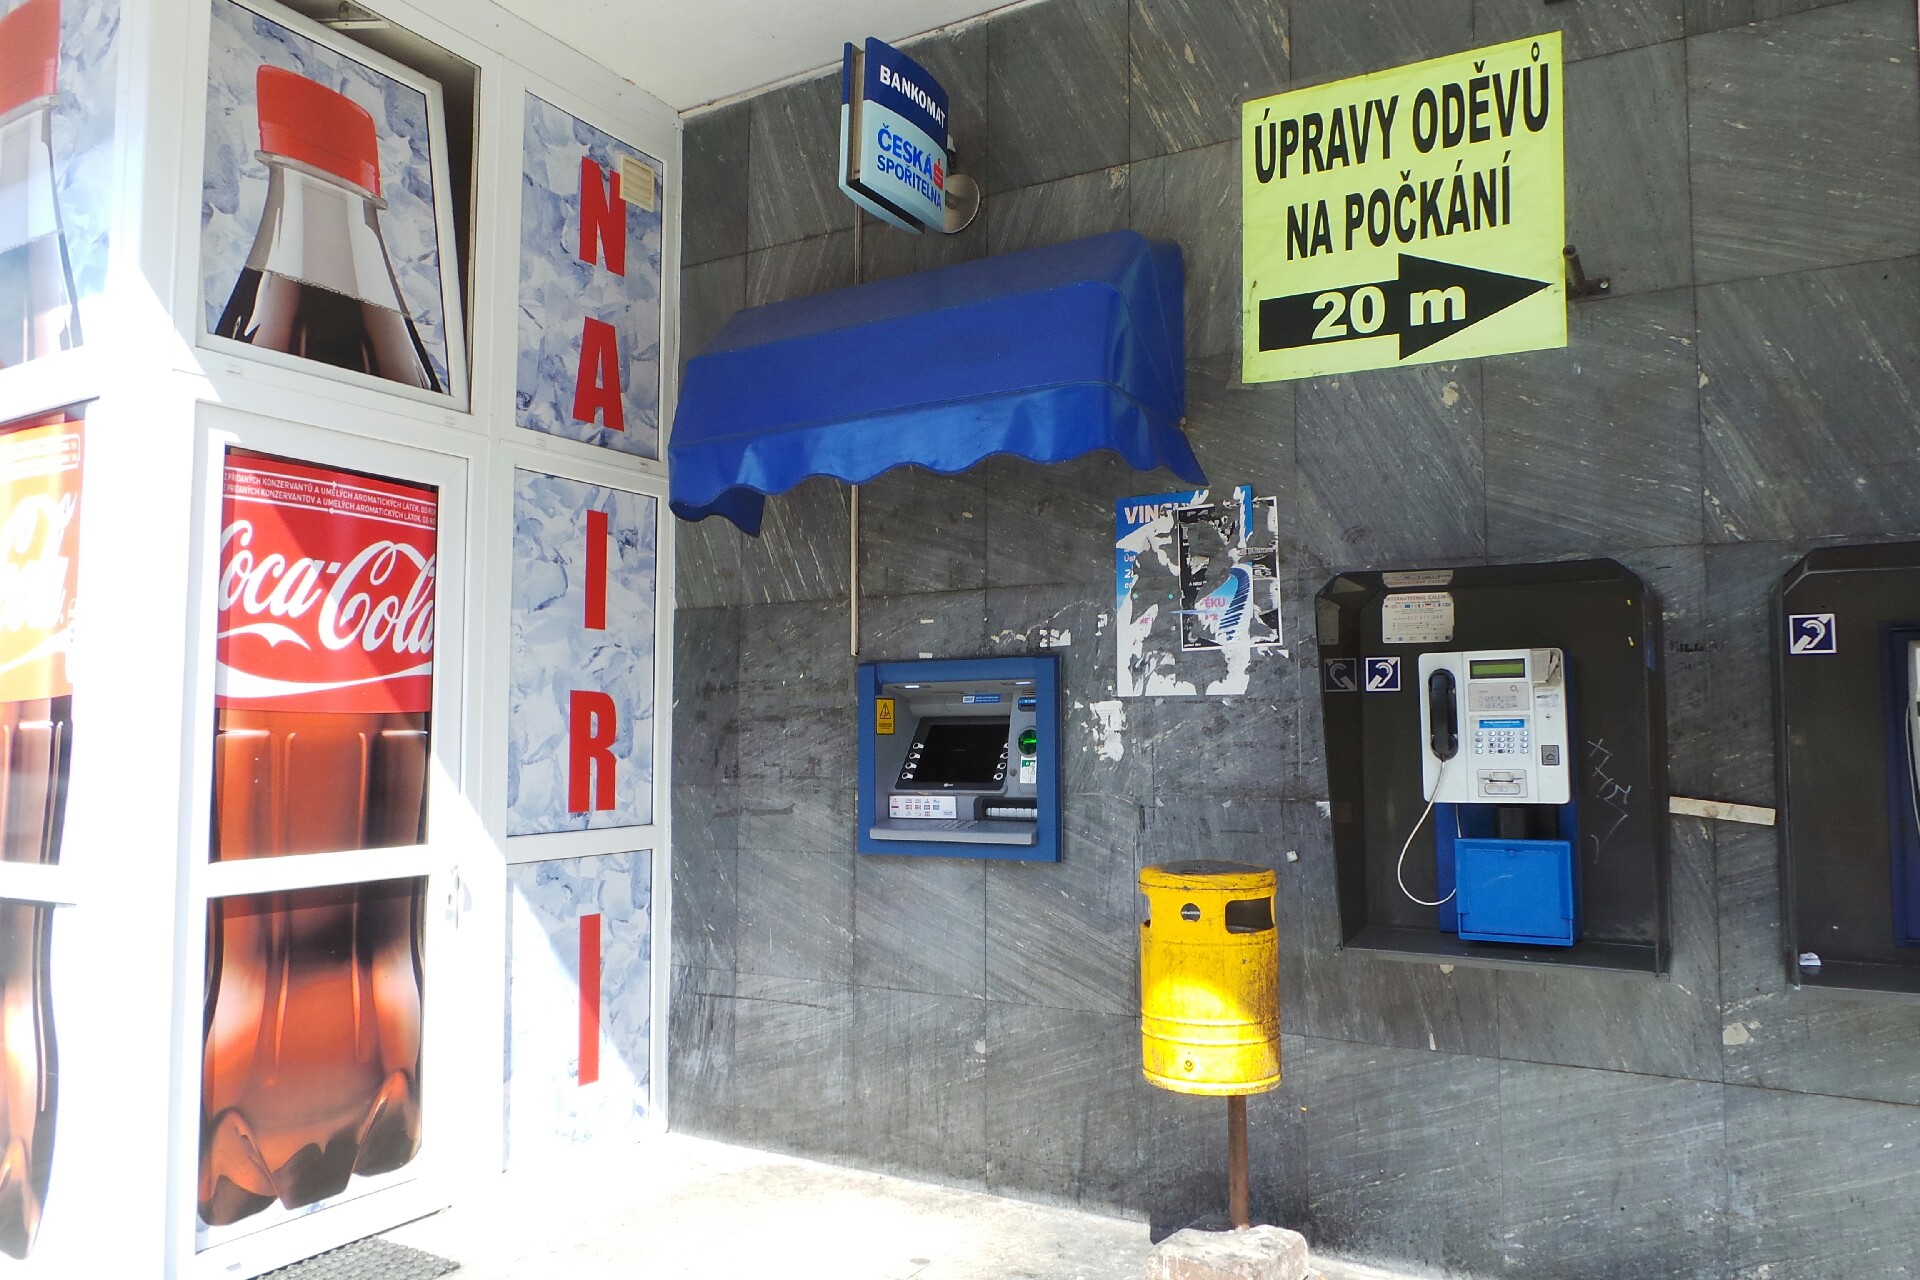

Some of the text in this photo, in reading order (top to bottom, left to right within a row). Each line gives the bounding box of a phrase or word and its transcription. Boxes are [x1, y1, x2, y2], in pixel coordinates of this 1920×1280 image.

[879, 64, 946, 129] BANKOMAT
[1254, 42, 1549, 184] ÚPRAVY ODĚVŮ
[877, 122, 933, 181] ČESKÁ
[876, 154, 943, 212] SPOŘITELNA
[1286, 150, 1511, 261] NA POČKÁNÍ
[1311, 285, 1467, 340] 20 m
[261, 489, 316, 504] KONZERVANTOV
[356, 502, 404, 518] AROMATICKÝCH
[263, 477, 313, 493] KONZERVANTŮ
[354, 491, 402, 507] AROMATICKÝCH
